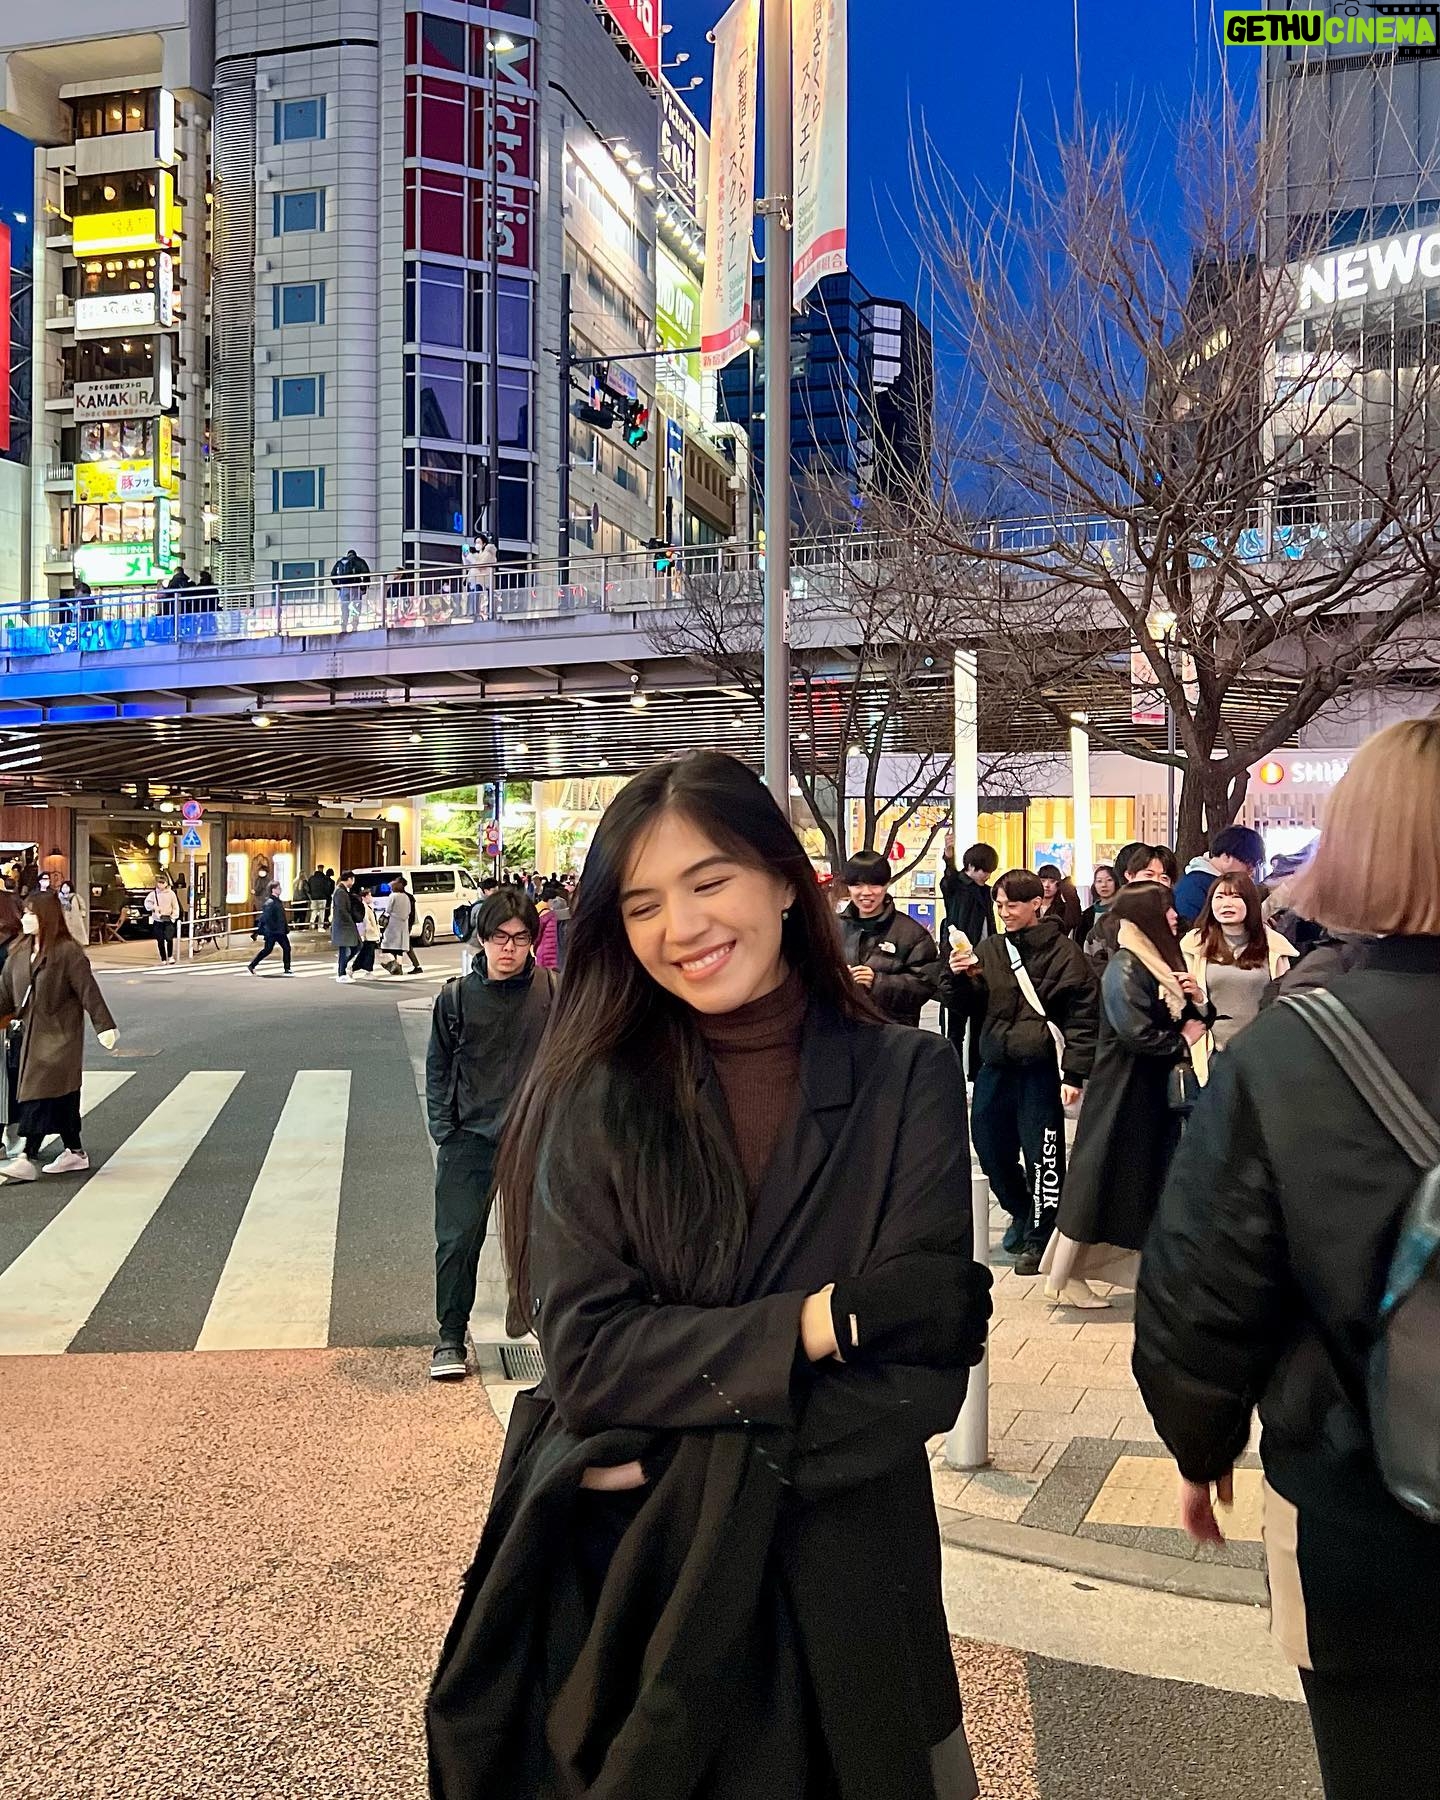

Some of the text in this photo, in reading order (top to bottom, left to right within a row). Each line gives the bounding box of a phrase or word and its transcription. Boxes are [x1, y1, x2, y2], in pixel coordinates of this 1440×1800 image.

[488, 43, 529, 258] Victoria
[661, 88, 695, 150] Victoria
[661, 119, 695, 190] Golf
[1042, 1127, 1060, 1209] ESPOIR
